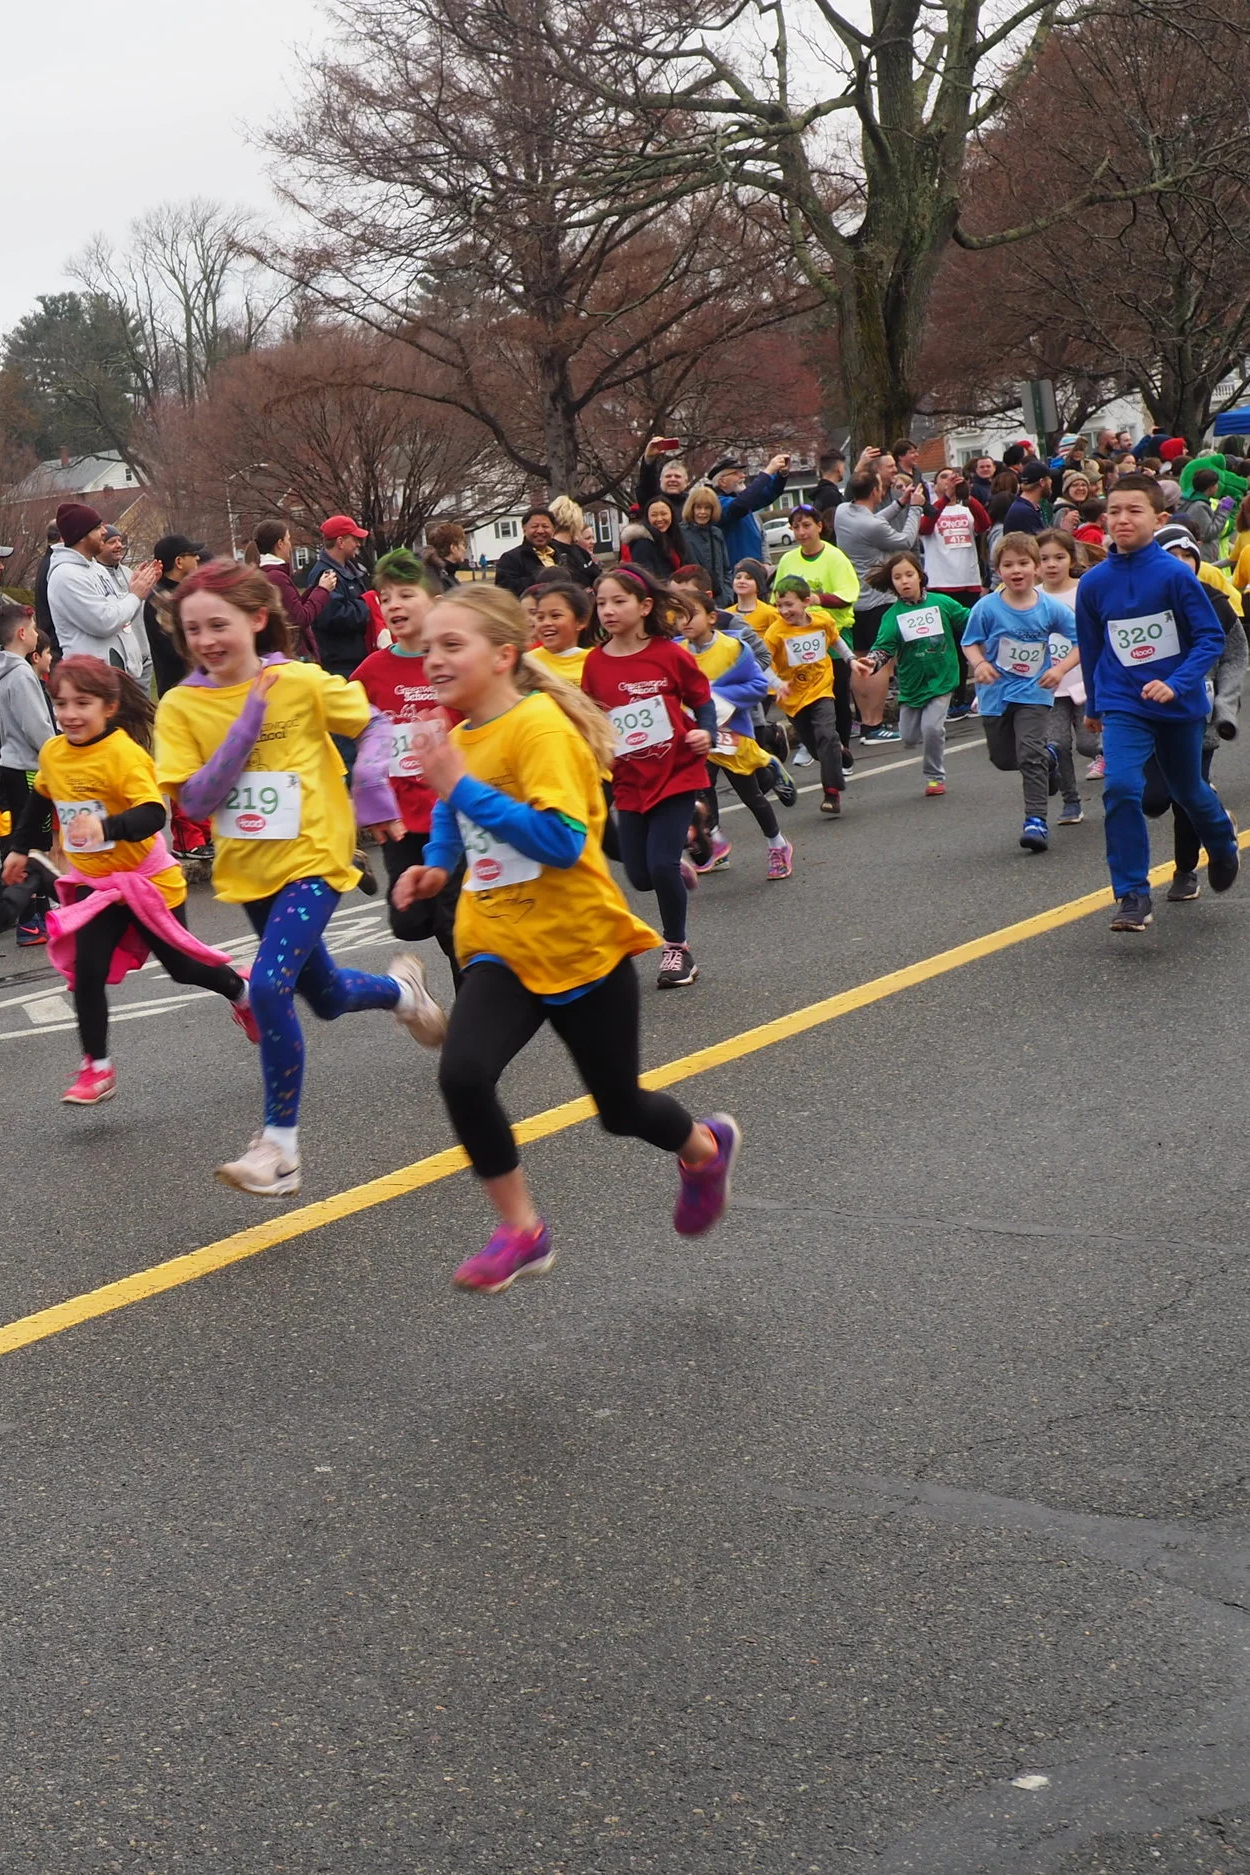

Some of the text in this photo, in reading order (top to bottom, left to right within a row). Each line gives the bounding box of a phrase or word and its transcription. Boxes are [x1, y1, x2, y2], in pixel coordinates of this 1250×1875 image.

[950, 535, 966, 543] 412
[907, 612, 935, 629] 226
[1117, 623, 1163, 649] 320
[792, 638, 821, 653] 209
[1050, 643, 1070, 659] 03
[1131, 647, 1154, 658] Hood
[1009, 647, 1040, 662] 102
[617, 677, 669, 692] Greenwood
[628, 685, 659, 696] School
[613, 708, 654, 736] 303
[225, 786, 278, 815] 219
